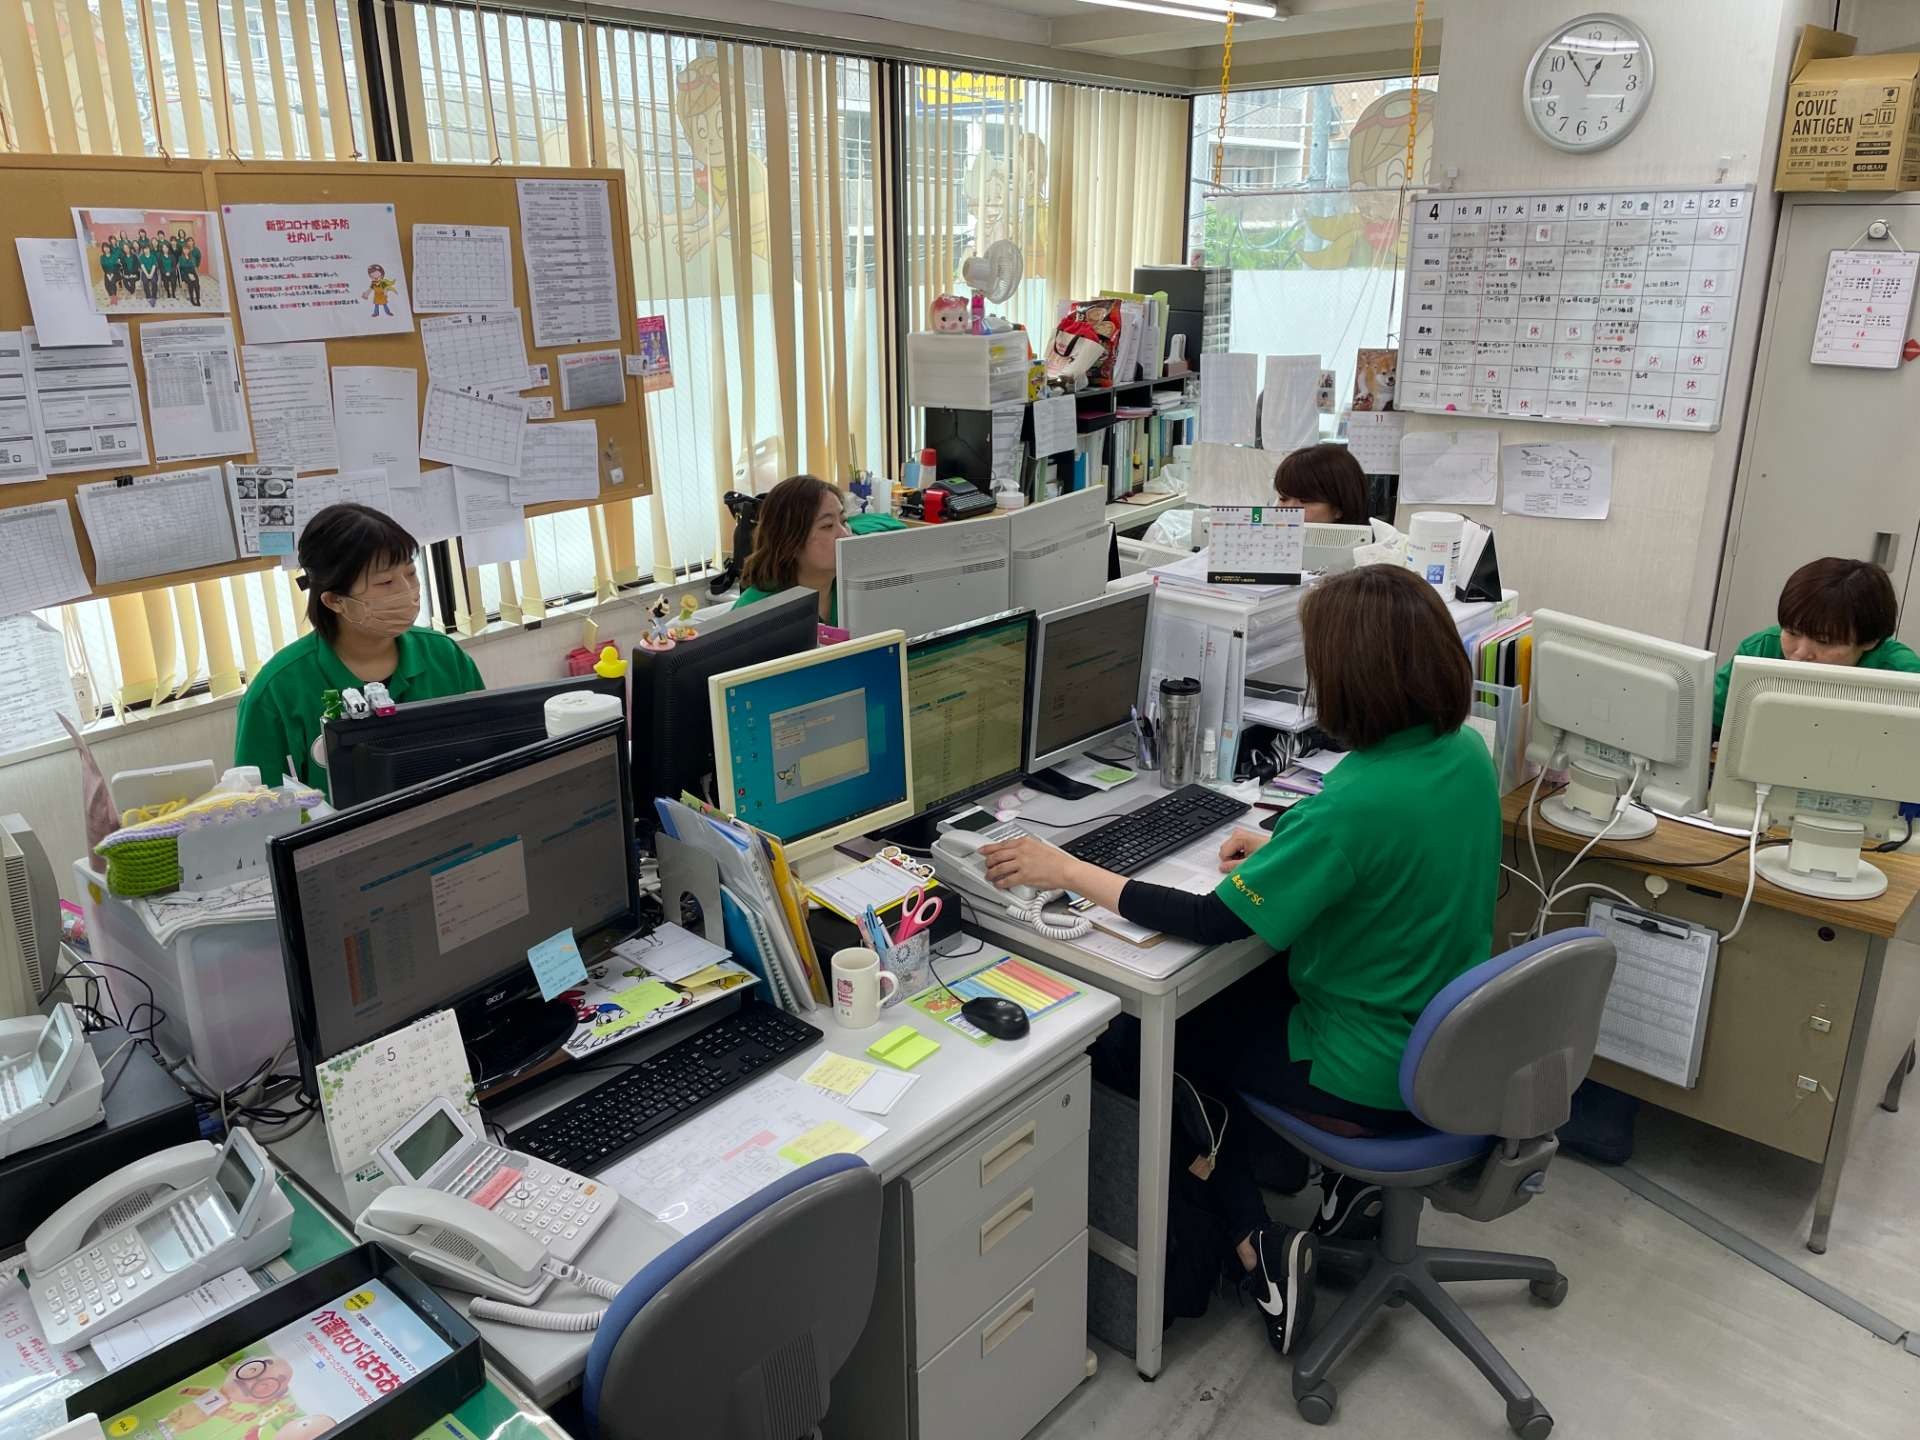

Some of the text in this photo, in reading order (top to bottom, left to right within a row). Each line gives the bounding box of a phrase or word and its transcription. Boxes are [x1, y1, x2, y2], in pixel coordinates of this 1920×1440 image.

[1550, 56, 1566, 72] 10
[1622, 53, 1633, 69] 2
[1542, 79, 1553, 95] 9
[1625, 75, 1637, 91] 3
[1546, 101, 1557, 117] 8
[1615, 97, 1625, 113] 4
[1559, 116, 1569, 132] 7
[1576, 120, 1587, 136] 6
[1598, 116, 1608, 131] 5
[1792, 117, 1854, 136] ANTIGEN
[1429, 198, 1738, 220] 4 16 月 17 火 18 水 19 木 20 金 21 土 22 日
[266, 218, 350, 231] 新型コロナ感染予防
[1713, 224, 1725, 236] 休
[287, 232, 333, 243] 社内ルール
[1704, 279, 1714, 289] 休
[1701, 304, 1712, 315] 休
[1529, 326, 1540, 336] 休
[1697, 329, 1707, 339] 休
[1692, 355, 1703, 365] 休
[1487, 370, 1496, 379] 休
[1686, 380, 1696, 390] 休
[1520, 400, 1529, 409] 休
[1656, 409, 1666, 418] 休
[1686, 407, 1697, 417] 休
[387, 1046, 396, 1062] 5
